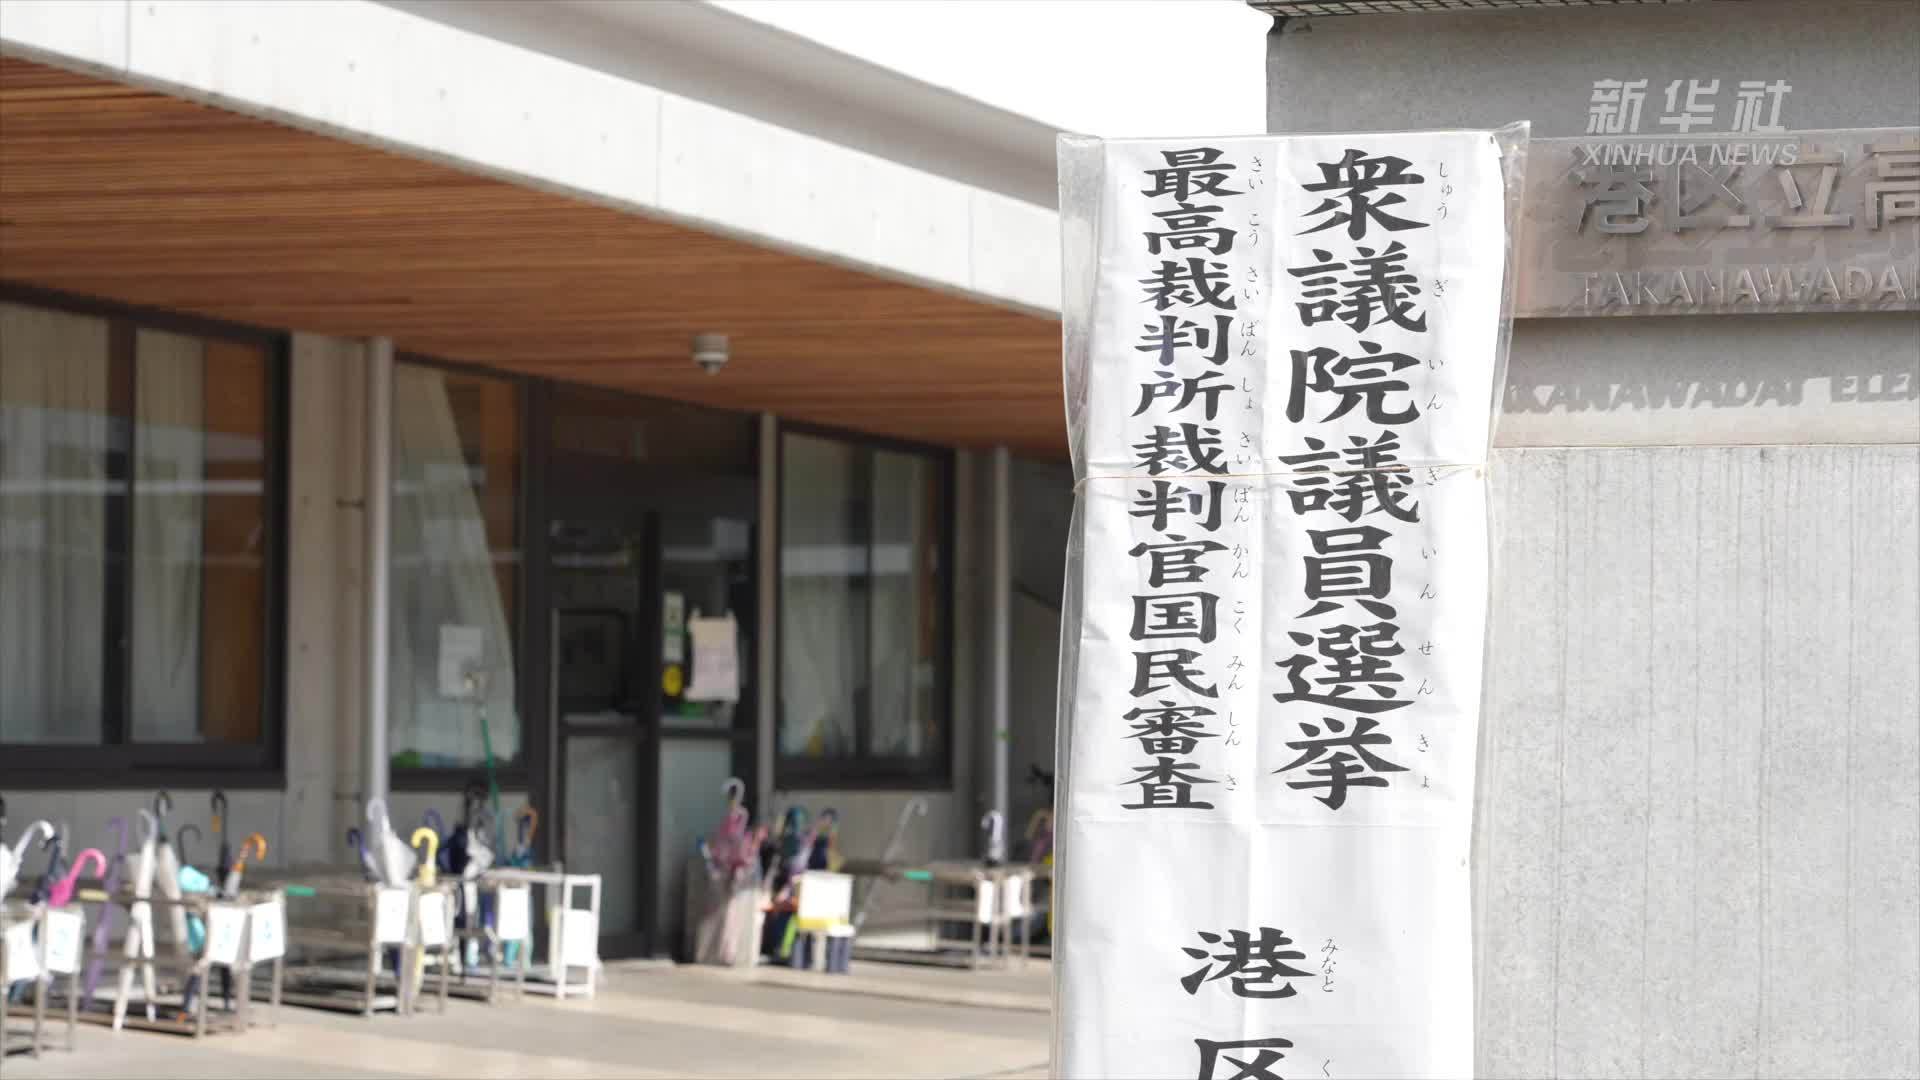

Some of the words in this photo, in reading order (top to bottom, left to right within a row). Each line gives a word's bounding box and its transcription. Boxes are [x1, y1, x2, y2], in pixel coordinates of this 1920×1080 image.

[1120, 147, 1246, 811] 最高裁判所裁判官国民審査
[1271, 148, 1431, 811] 衆議院議員選挙
